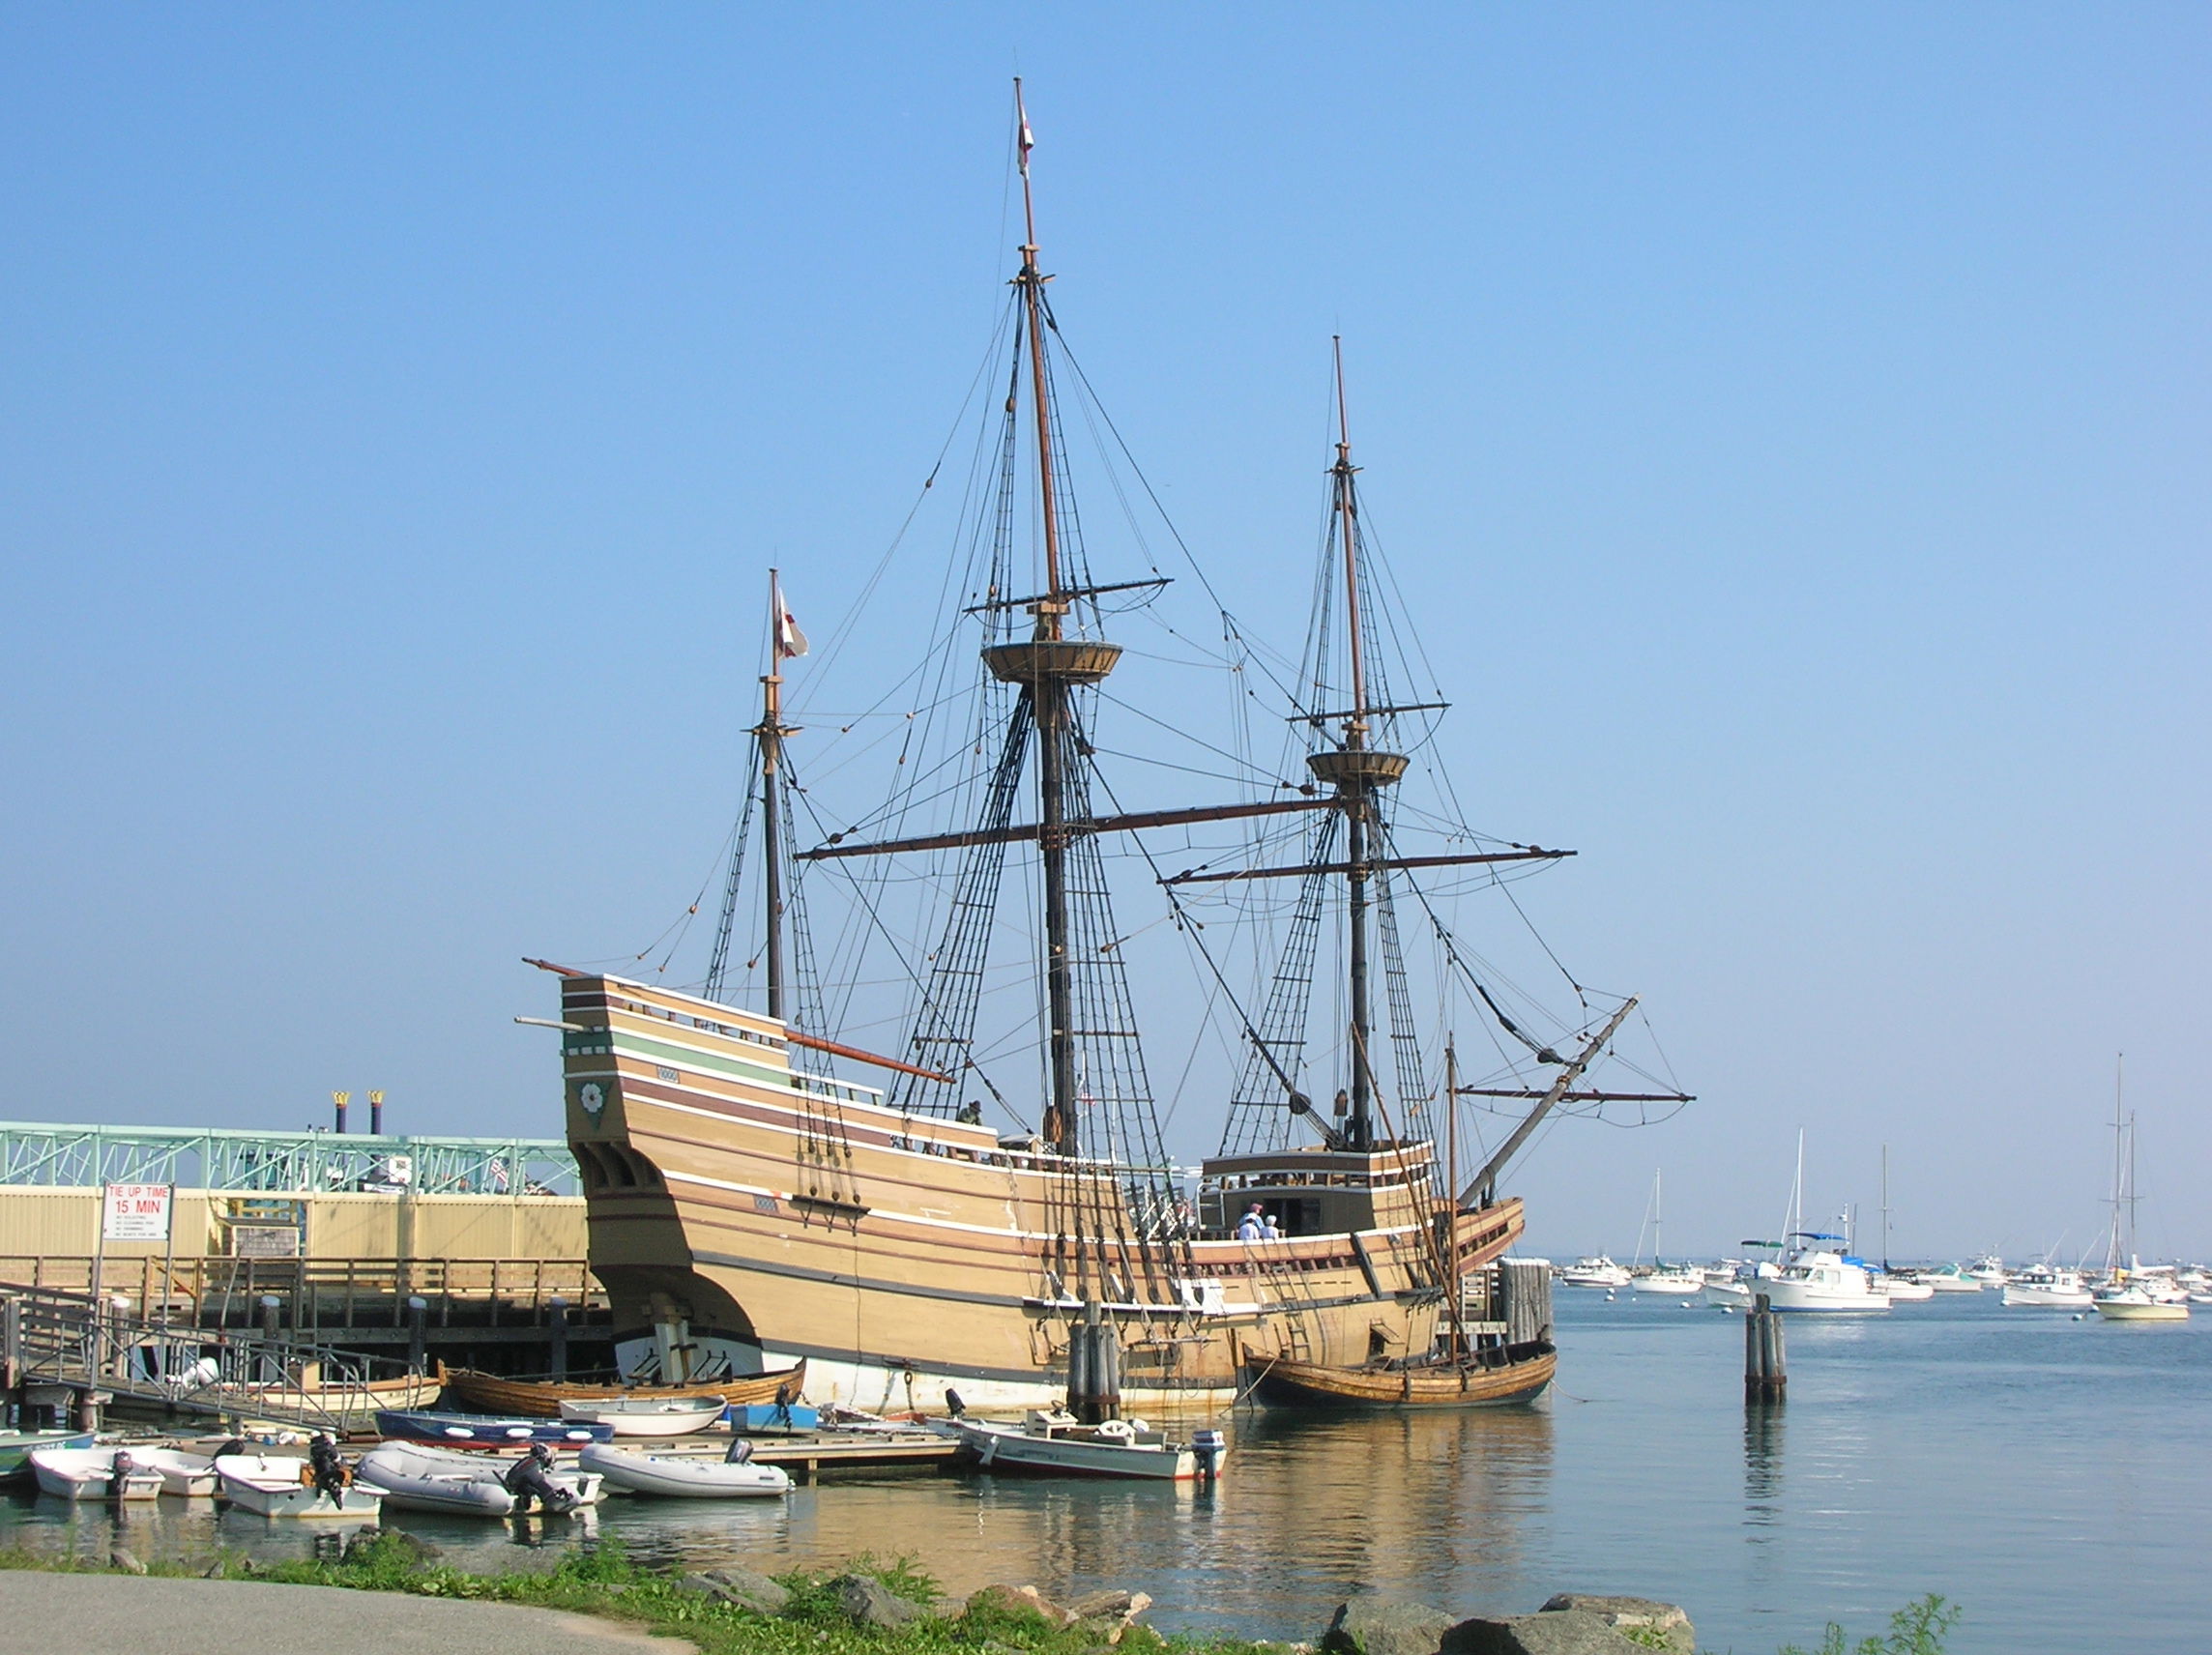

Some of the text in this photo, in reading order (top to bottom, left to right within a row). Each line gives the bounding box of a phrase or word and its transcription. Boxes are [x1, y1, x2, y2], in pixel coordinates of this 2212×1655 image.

[109, 1186, 168, 1198] TIE UP TIME
[116, 1200, 160, 1213] 15 MIN
